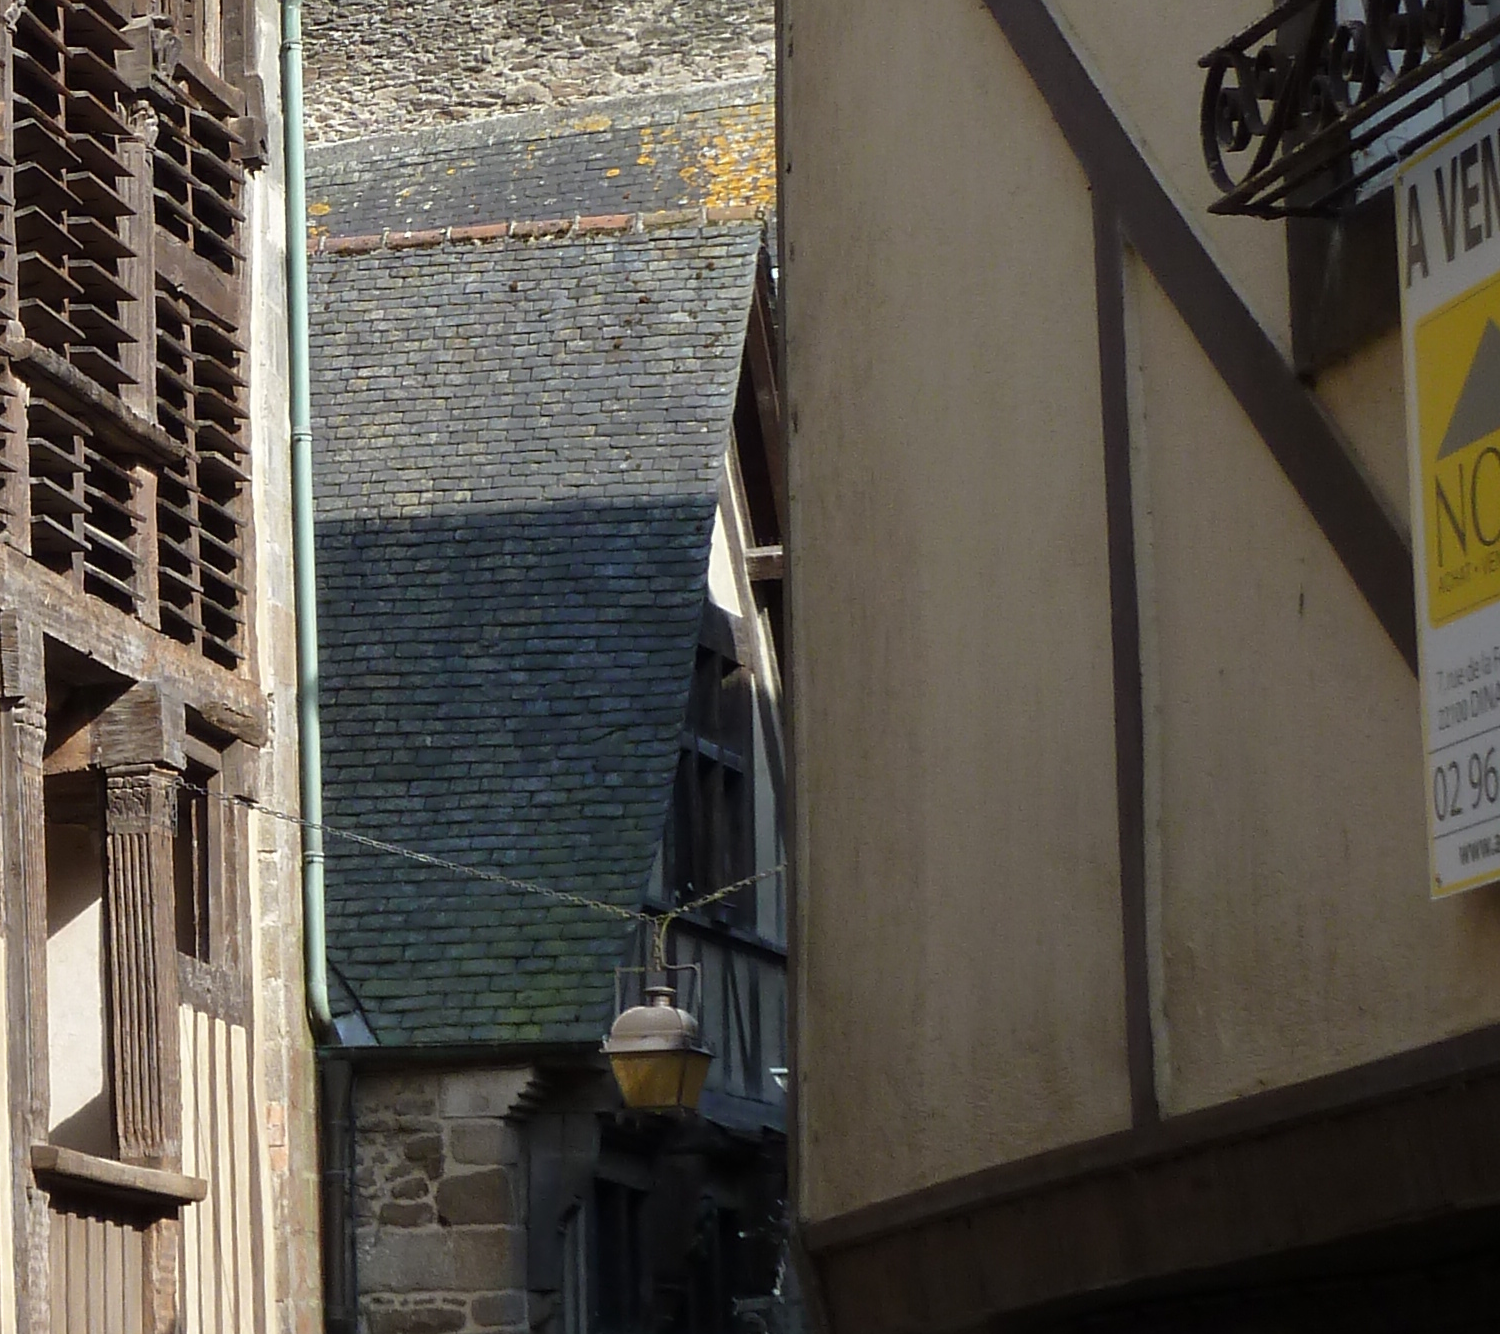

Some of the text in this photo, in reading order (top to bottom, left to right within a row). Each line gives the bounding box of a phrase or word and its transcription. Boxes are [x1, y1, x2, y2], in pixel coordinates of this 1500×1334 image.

[1406, 183, 1429, 289] A
[1434, 747, 1498, 822] 02 96
